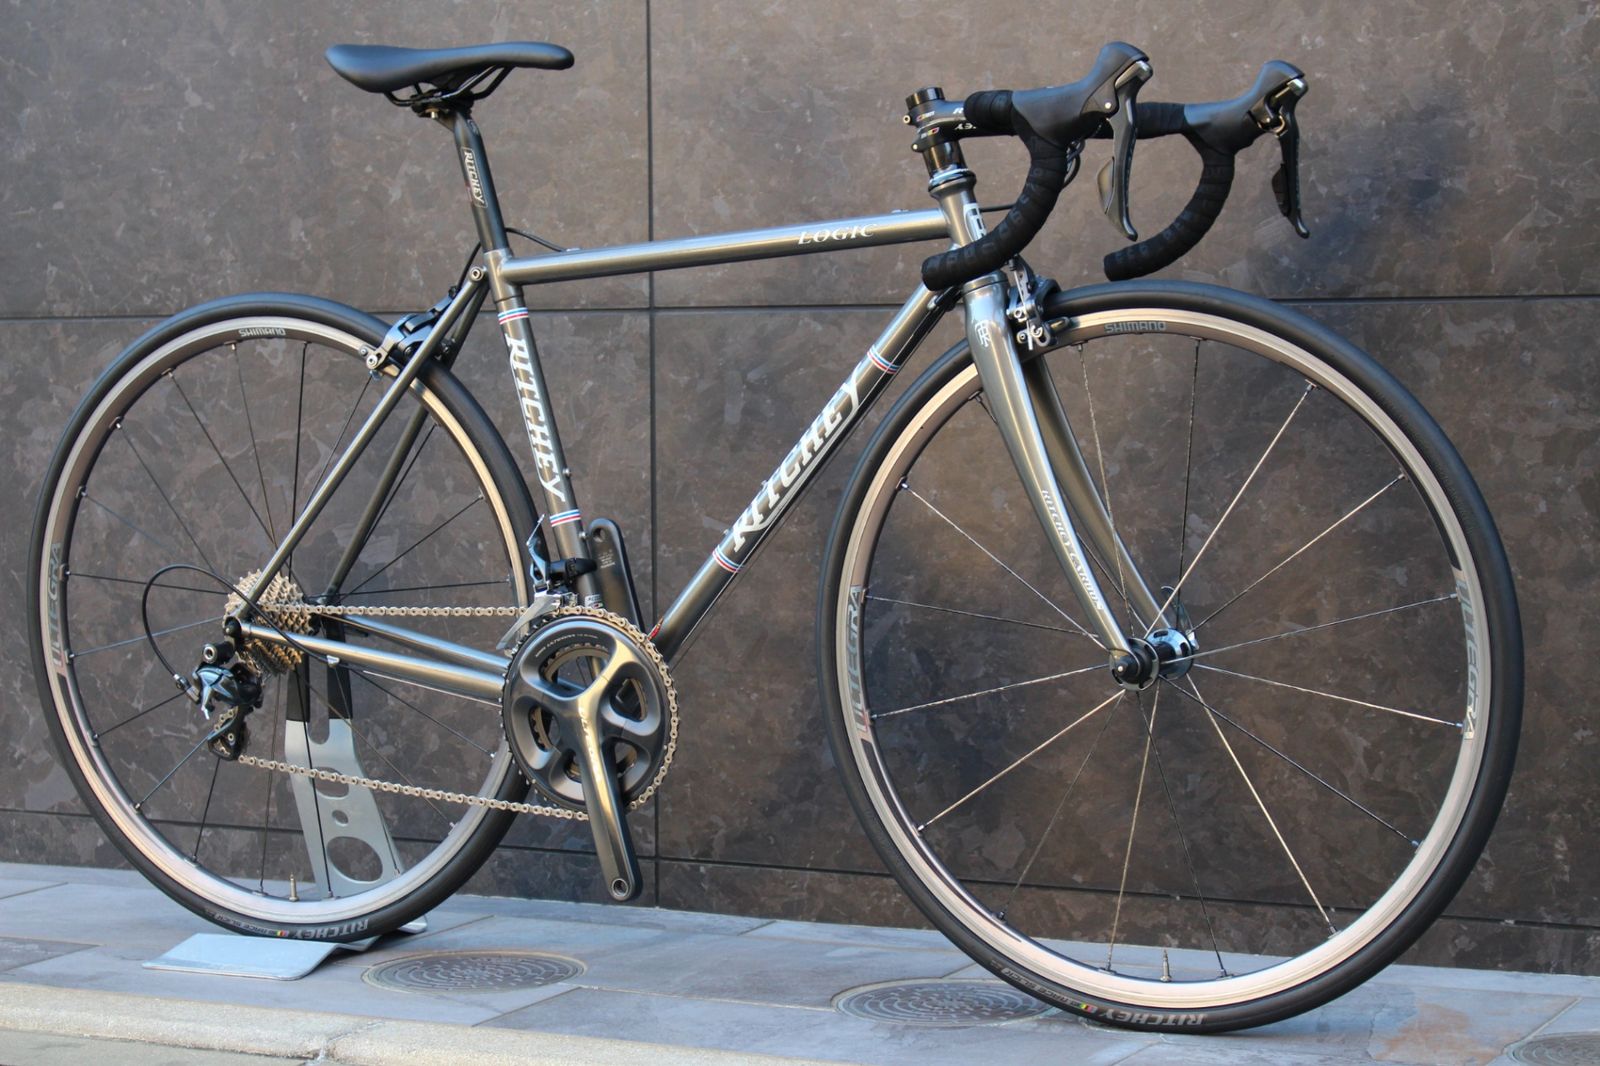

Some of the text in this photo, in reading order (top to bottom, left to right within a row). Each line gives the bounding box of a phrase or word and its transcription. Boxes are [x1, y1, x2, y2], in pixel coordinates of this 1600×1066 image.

[463, 150, 485, 205] RITCHEY
[798, 223, 877, 245] LOGIC
[238, 327, 286, 338] SHIMANO
[1104, 320, 1168, 334] SHIMANO
[504, 333, 566, 502] RITCHEY
[733, 359, 866, 553] RITCHEY
[1455, 578, 1480, 740] ULTEGRA
[293, 918, 370, 940] RITCHEY
[1101, 1008, 1208, 1027] RITCHEY
